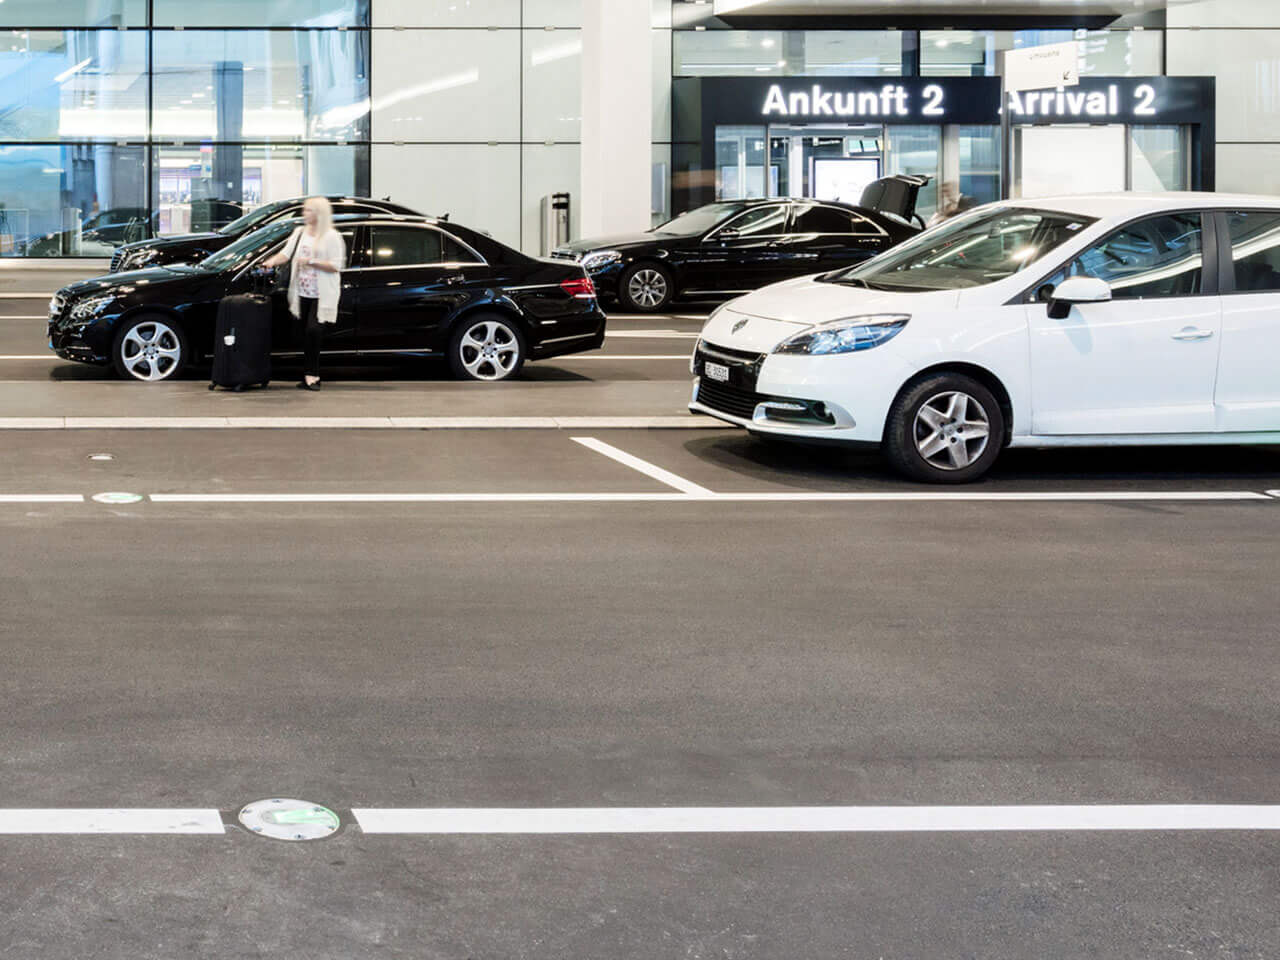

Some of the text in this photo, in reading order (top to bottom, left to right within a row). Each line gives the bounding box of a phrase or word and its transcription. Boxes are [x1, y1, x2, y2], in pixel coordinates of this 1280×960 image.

[762, 85, 945, 115] Ankunft 2
[1133, 85, 1156, 115] 2
